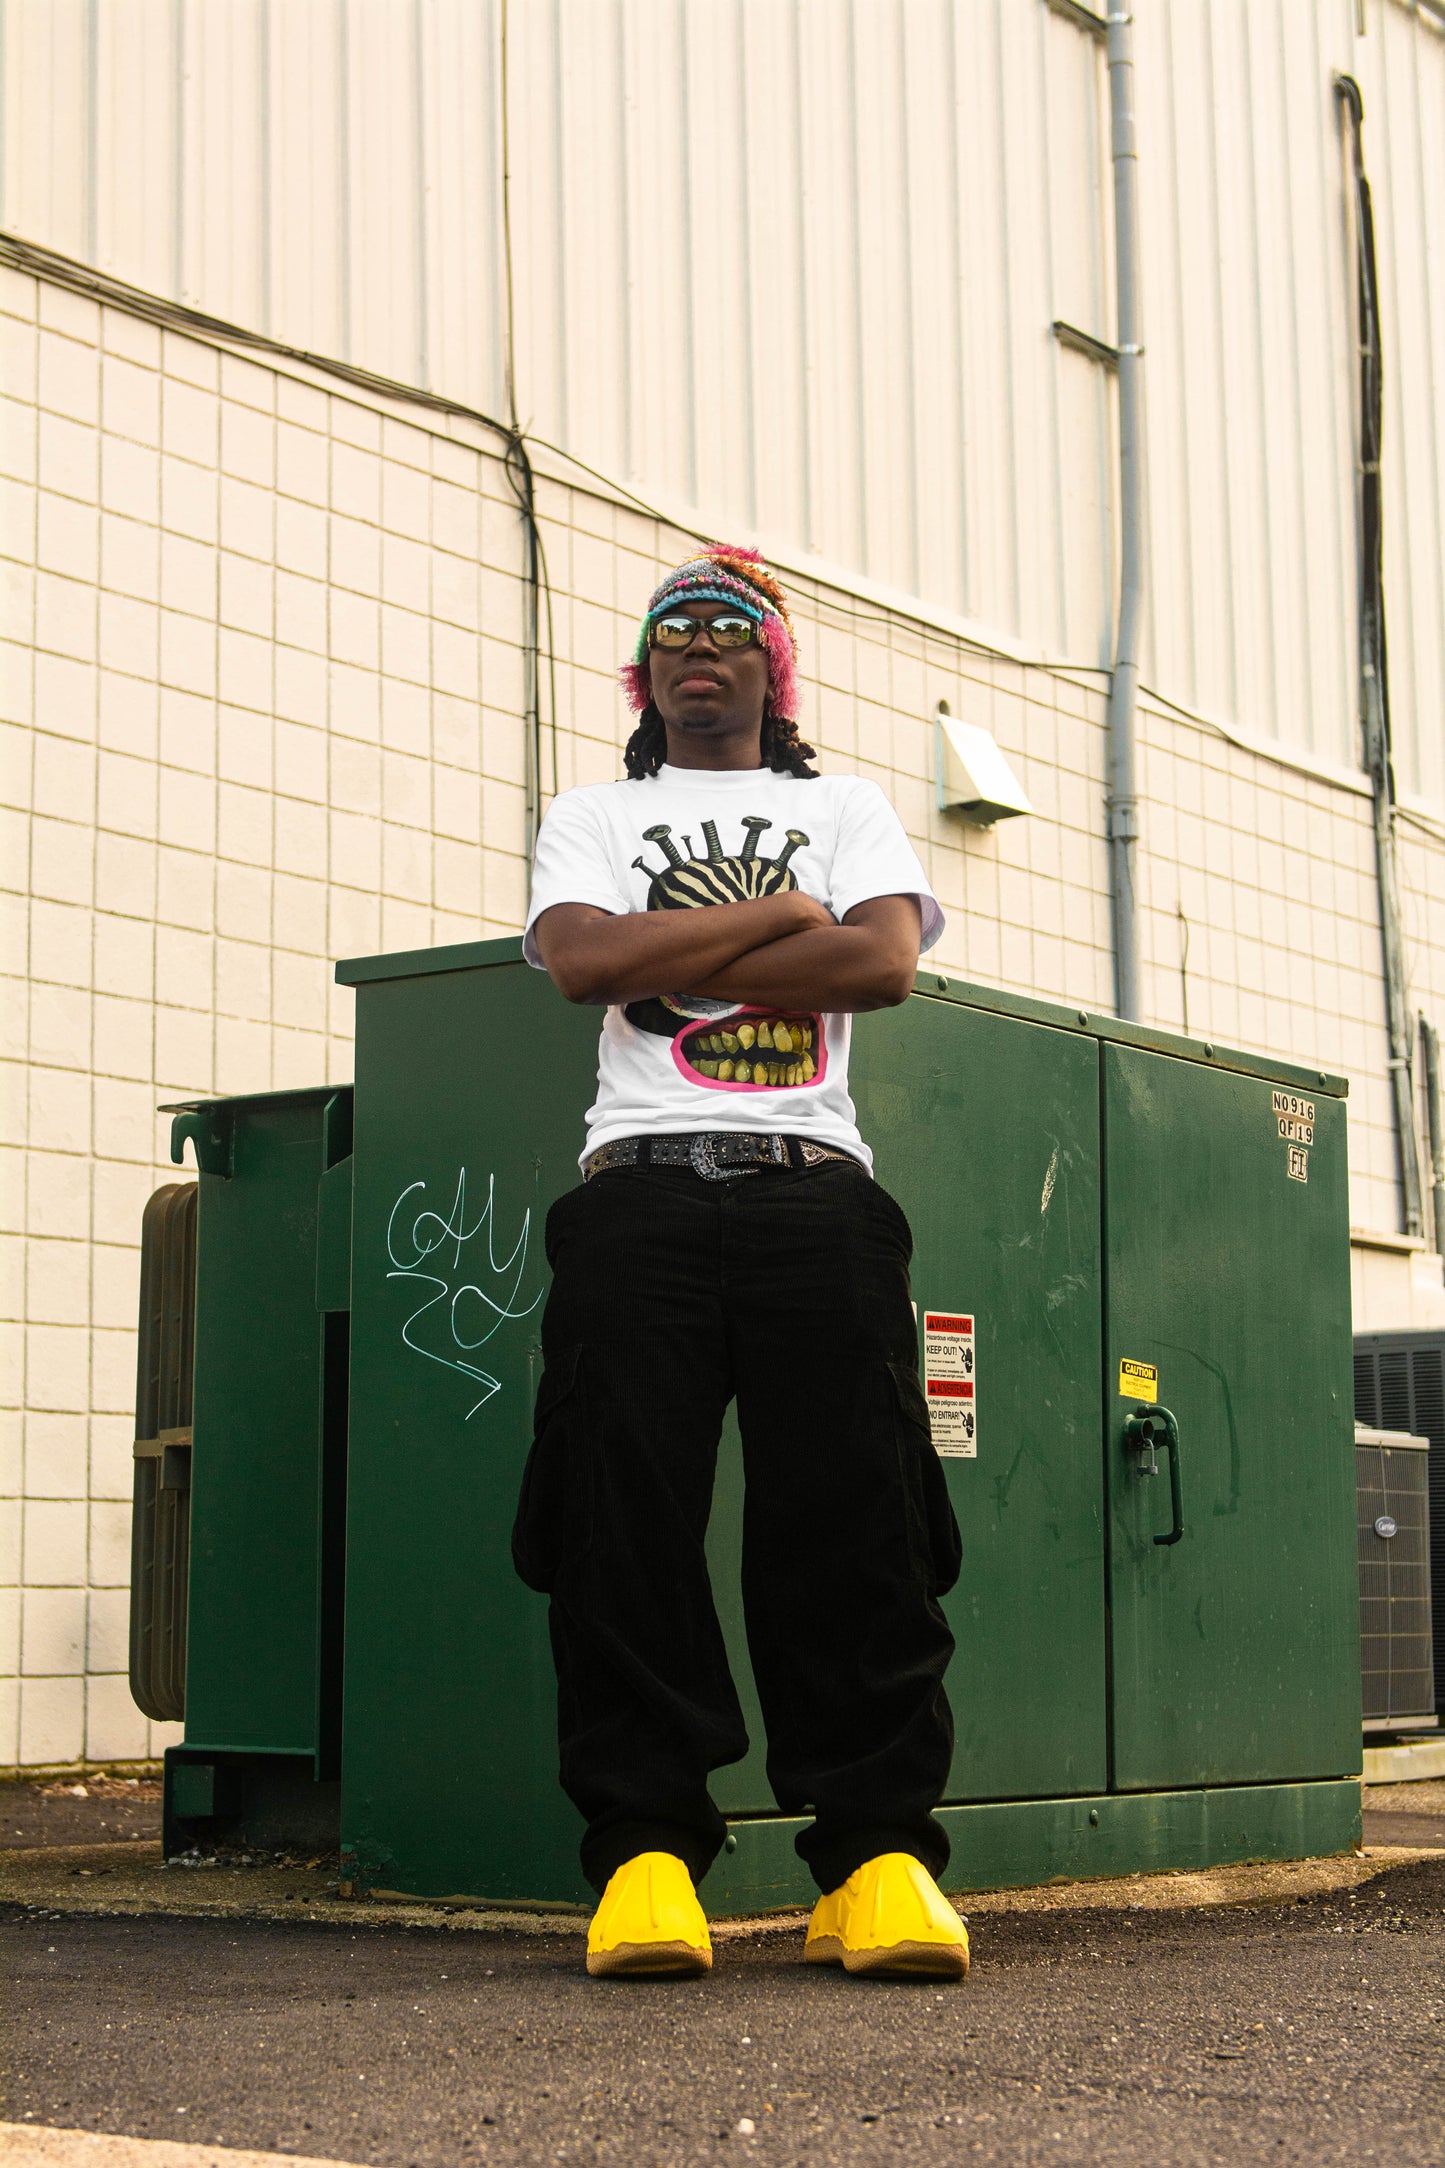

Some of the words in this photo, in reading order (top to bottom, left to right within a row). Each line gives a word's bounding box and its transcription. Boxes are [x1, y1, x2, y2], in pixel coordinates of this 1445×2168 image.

[935, 1318, 971, 1332] WARNING
[926, 1334, 946, 1342] Hazardous
[947, 1335, 960, 1344] voltage
[926, 1344, 942, 1355] KEEP
[943, 1346, 958, 1356] OUT!
[1125, 1363, 1153, 1379] CAUTION
[937, 1383, 972, 1396] ADVERTENCIA
[928, 1398, 940, 1406] Voltaje
[941, 1399, 958, 1408] peligroso
[938, 1410, 960, 1421] ENTRAR!
